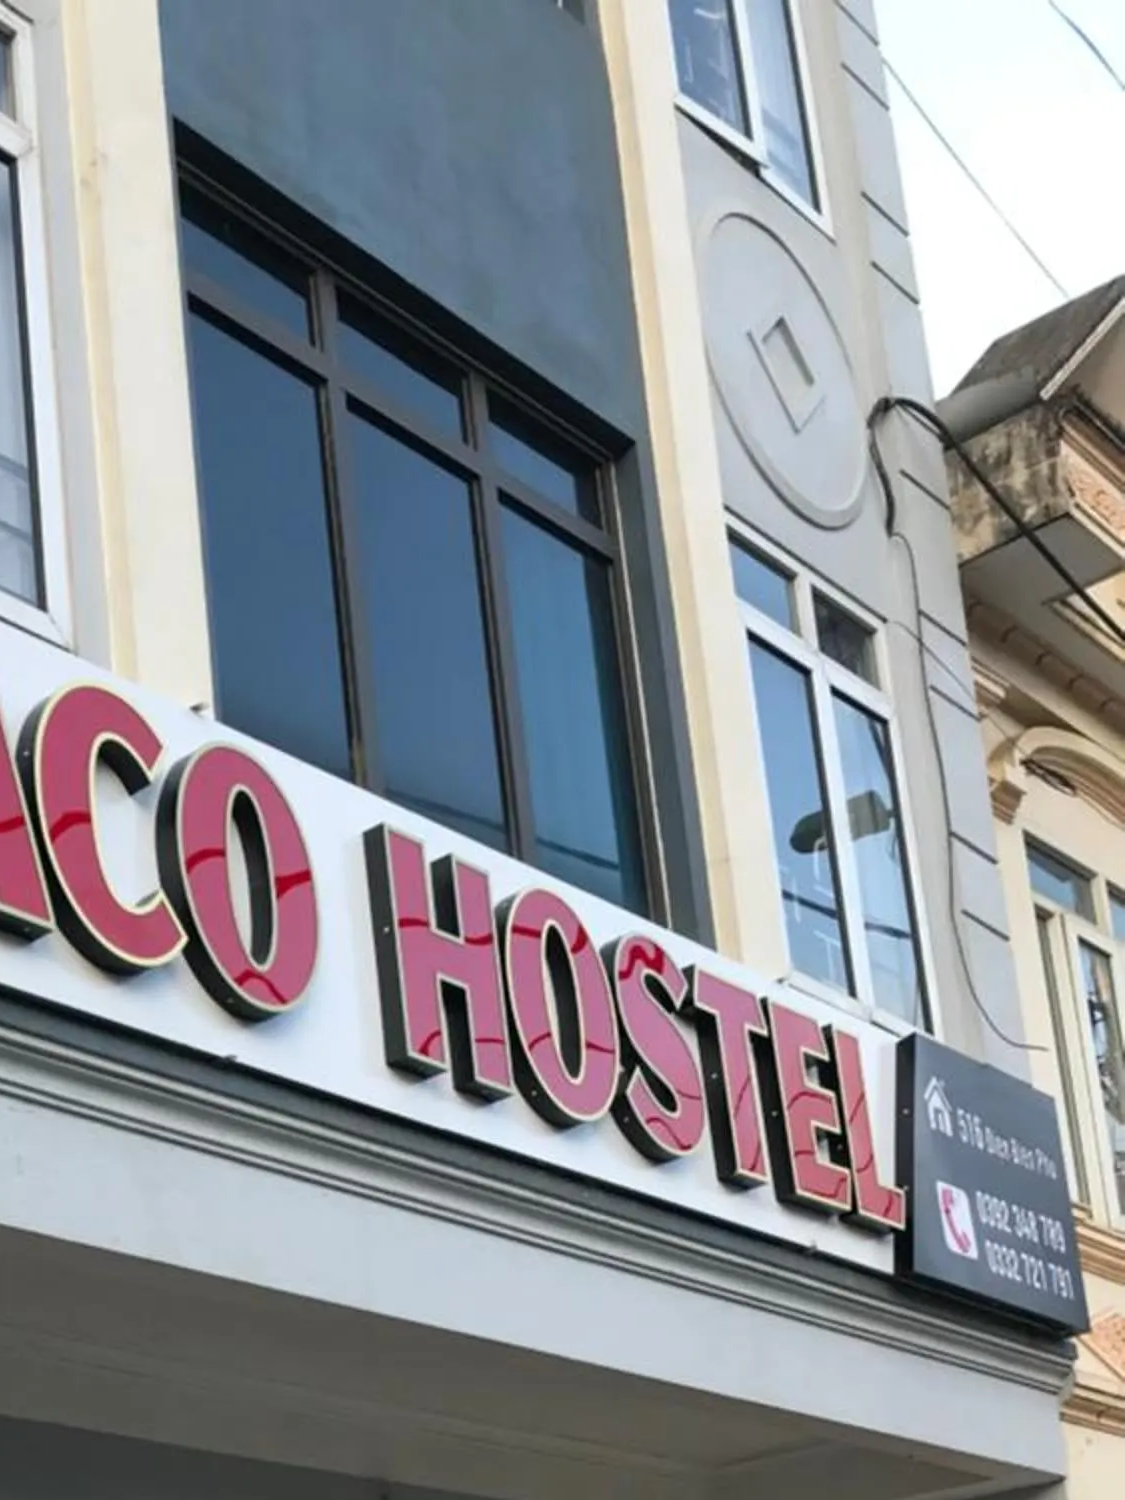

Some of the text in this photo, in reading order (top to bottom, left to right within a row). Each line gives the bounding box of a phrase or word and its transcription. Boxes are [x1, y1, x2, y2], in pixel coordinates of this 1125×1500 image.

[363, 823, 906, 1236] HOSTEL
[956, 1106, 984, 1150] 516
[1021, 1252, 1047, 1291] 721
[1047, 1263, 1074, 1299] 791
